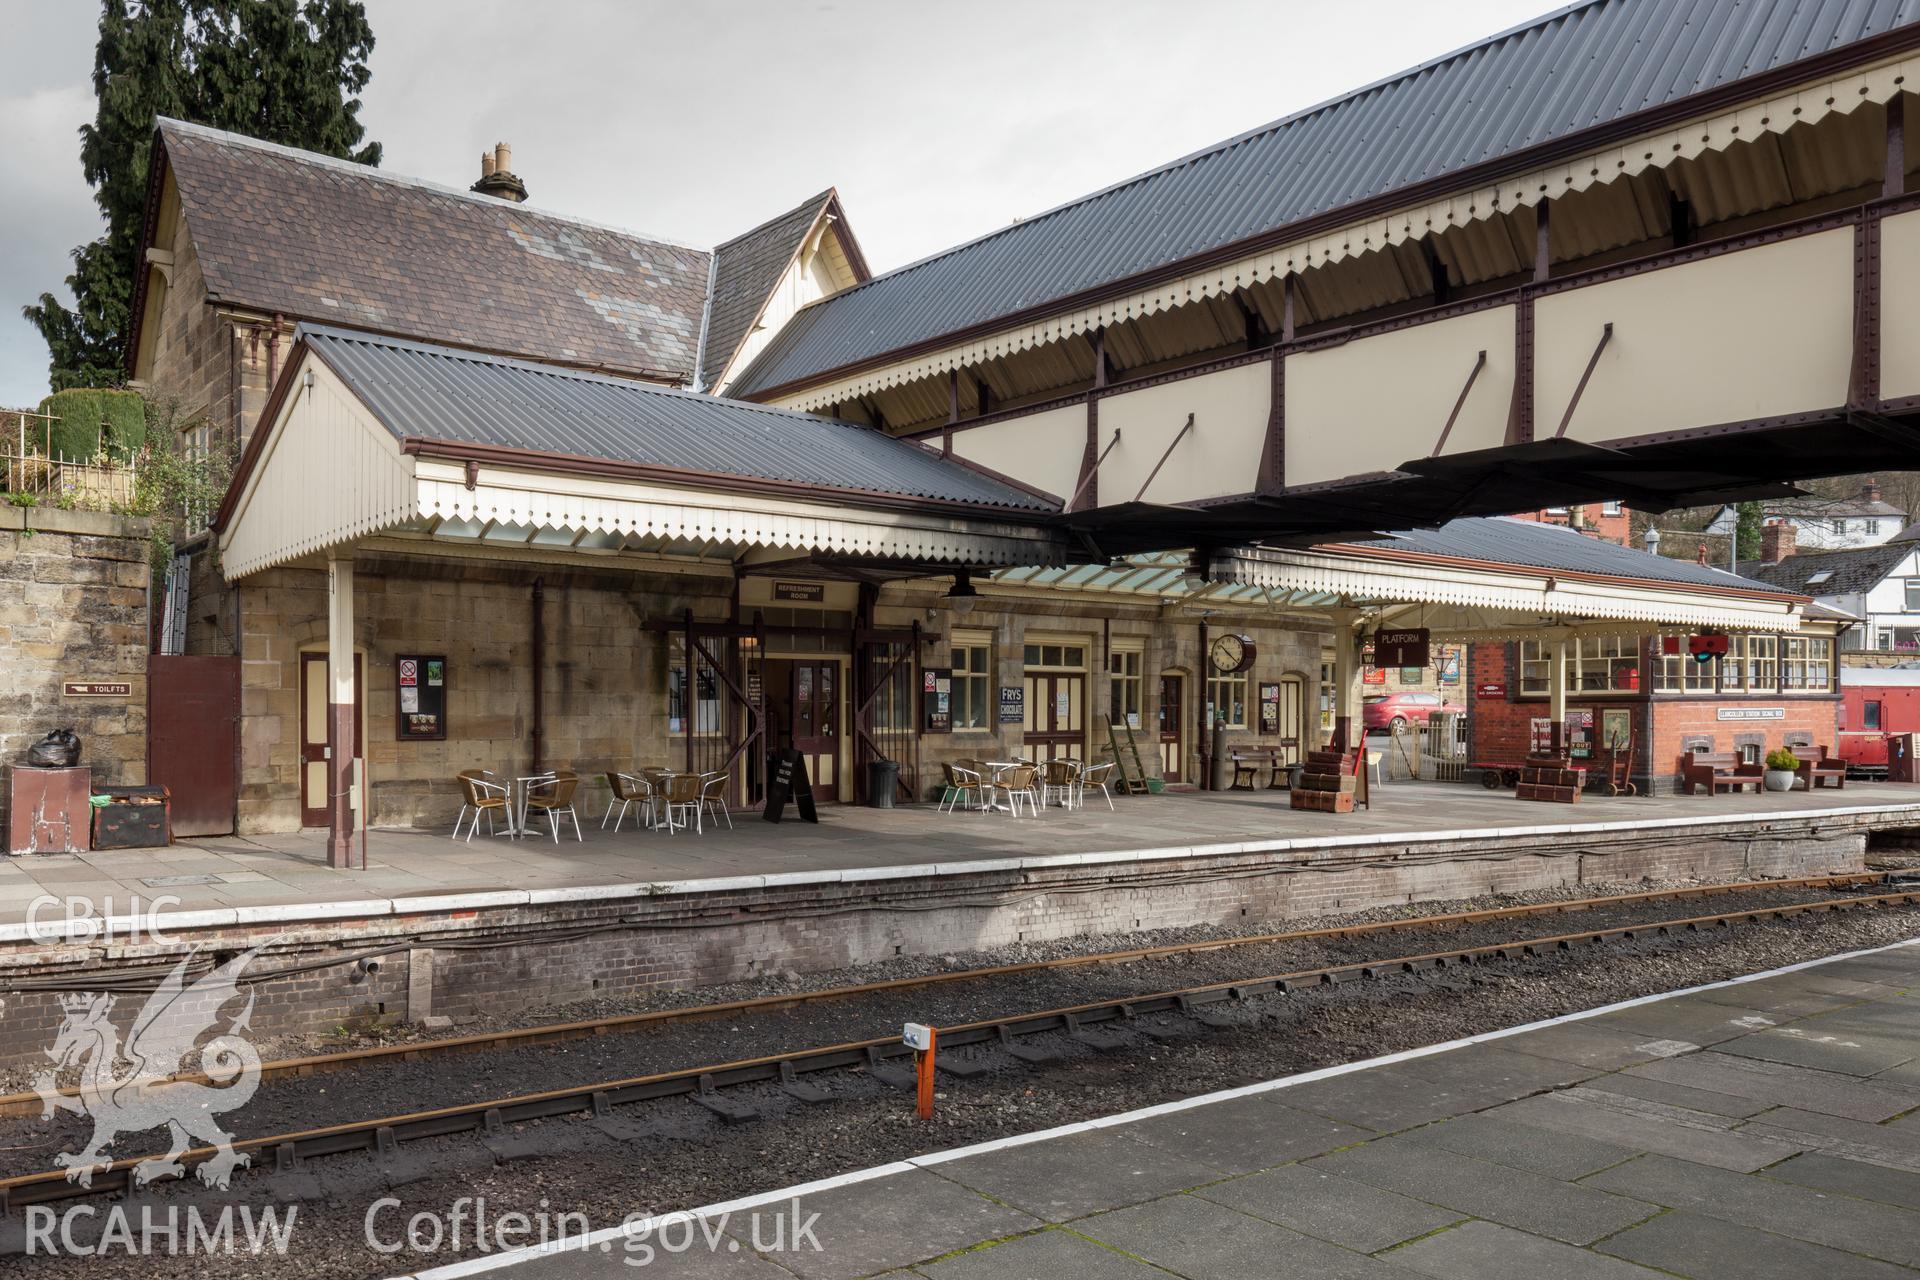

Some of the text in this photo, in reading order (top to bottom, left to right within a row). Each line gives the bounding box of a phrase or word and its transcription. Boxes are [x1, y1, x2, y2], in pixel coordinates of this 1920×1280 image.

[778, 584, 820, 593] REFRESHMENT
[1382, 634, 1419, 644] PLATFORM
[94, 685, 126, 693] TOILETS
[1000, 704, 1023, 714] CHOCOLATE
